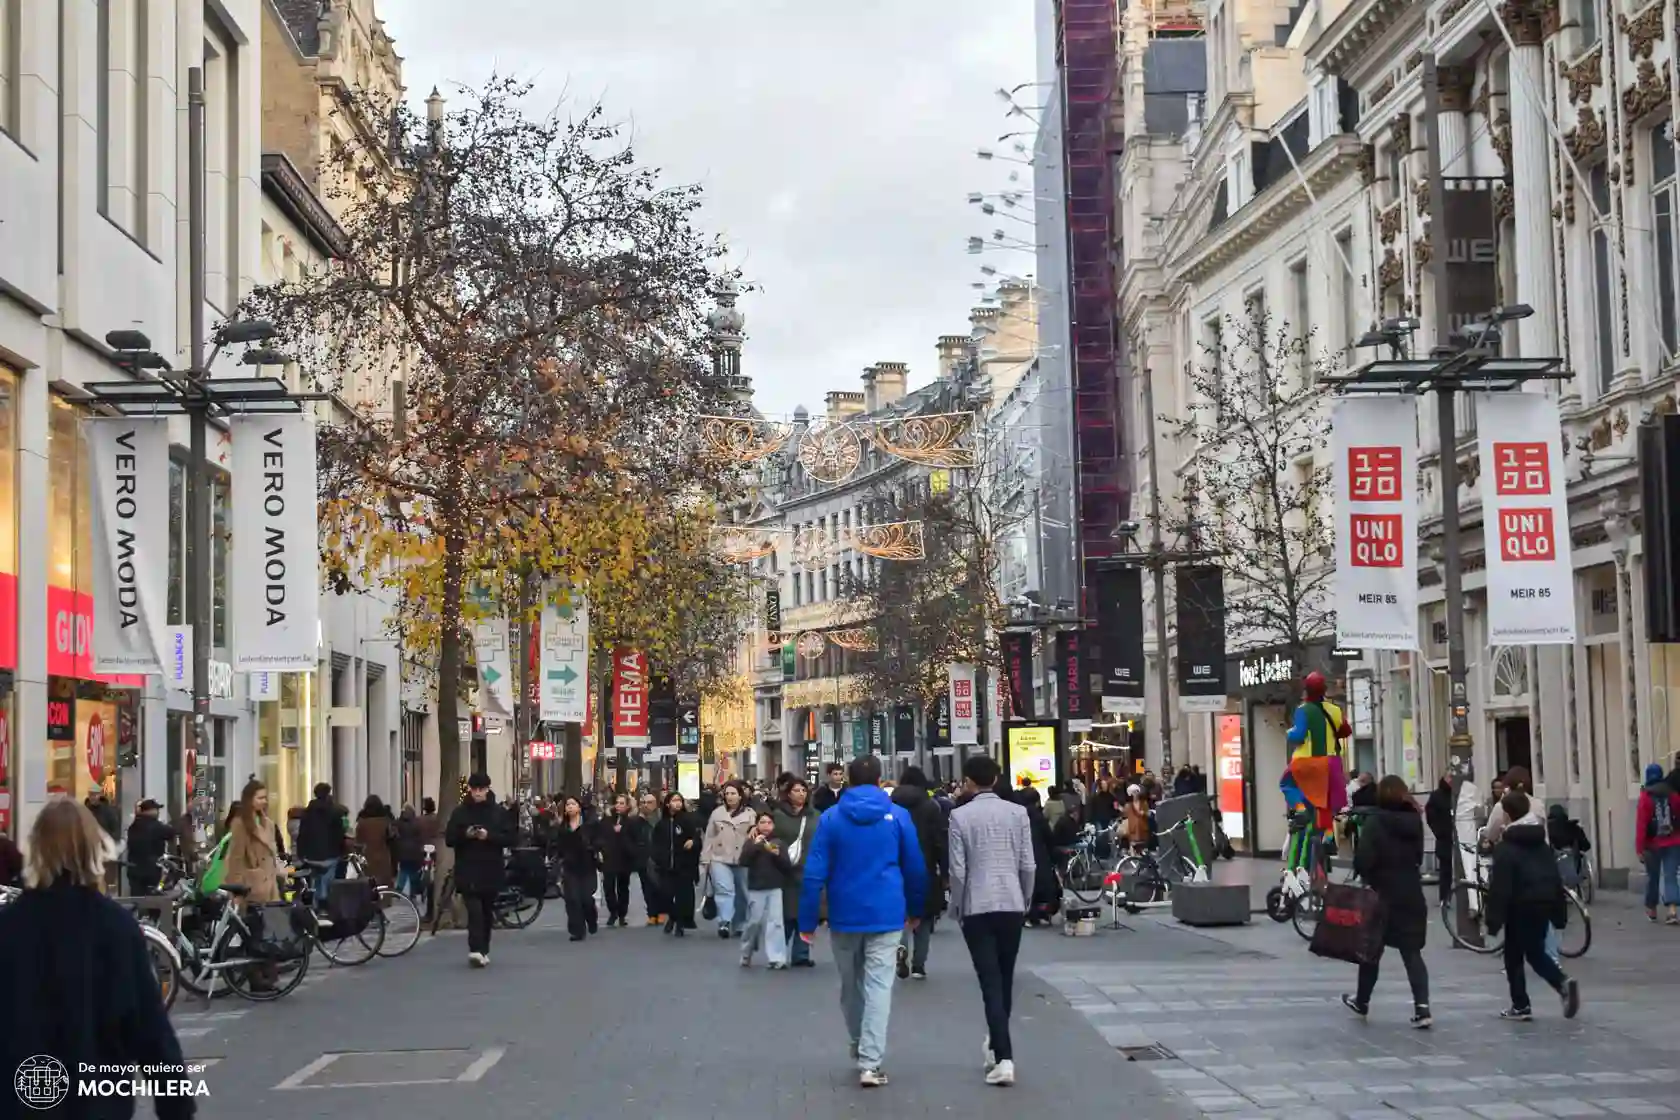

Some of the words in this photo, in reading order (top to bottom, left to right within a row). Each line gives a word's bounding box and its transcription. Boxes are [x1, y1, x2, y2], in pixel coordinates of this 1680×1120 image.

[115, 430, 136, 519] VERO
[264, 428, 284, 517] VERO
[1356, 520, 1393, 540] UNI
[1504, 514, 1544, 533] UNI
[1356, 542, 1397, 564] QLO
[1506, 536, 1549, 558] QLO
[117, 529, 138, 629] MODA
[265, 527, 286, 626] MODA
[1358, 593, 1383, 604] MEIR
[1385, 594, 1397, 604] 85
[1510, 588, 1536, 599] MEIR
[1538, 588, 1551, 598] 85
[1067, 656, 1079, 690] PARIS
[1114, 667, 1130, 677] WE
[1193, 665, 1211, 675] WE
[620, 653, 641, 726] HEMA
